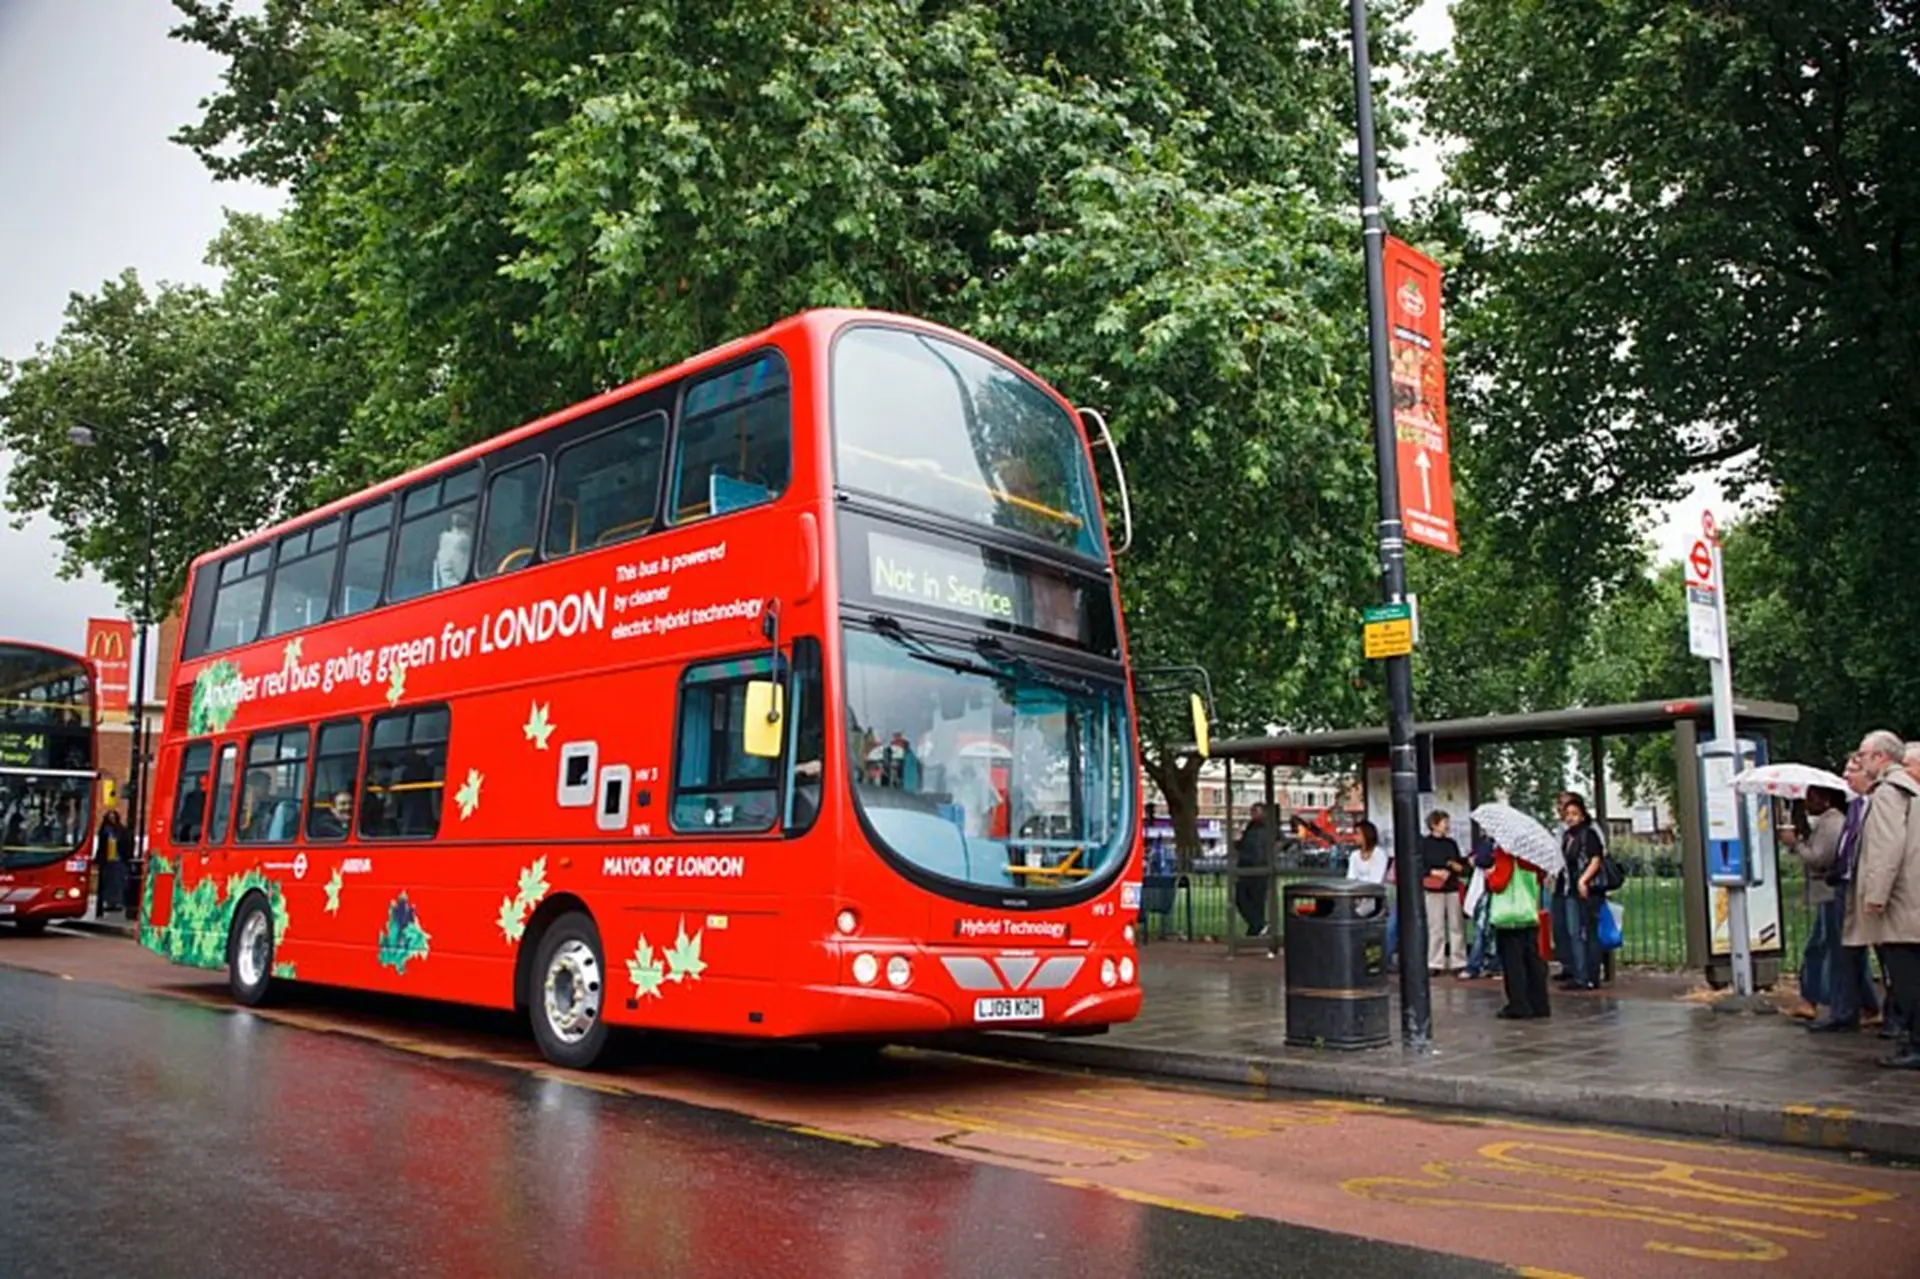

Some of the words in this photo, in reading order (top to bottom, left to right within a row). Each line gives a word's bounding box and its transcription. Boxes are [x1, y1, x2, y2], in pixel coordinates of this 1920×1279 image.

[616, 564, 636, 583] This
[638, 560, 659, 578] bus
[661, 556, 670, 572] is
[671, 540, 726, 574] powered
[613, 593, 628, 613] by
[628, 586, 671, 607] cleaner
[875, 555, 916, 593] Not
[923, 570, 940, 600] in
[947, 574, 1012, 616] Service
[611, 617, 653, 640] electric
[653, 609, 690, 635] hybrid
[691, 598, 764, 626] technology
[202, 672, 261, 708] Another
[262, 661, 289, 698] red
[290, 660, 320, 692] bus
[322, 647, 375, 693] going
[376, 636, 435, 683] green
[440, 622, 477, 661] for
[480, 586, 607, 654] LONDON
[602, 856, 651, 877] MAYOR
[654, 856, 675, 877] OF
[676, 856, 744, 877] LONDON
[960, 919, 1001, 937] Hybrid
[1002, 919, 1066, 938] Technology
[979, 1000, 1011, 1017] LJ09
